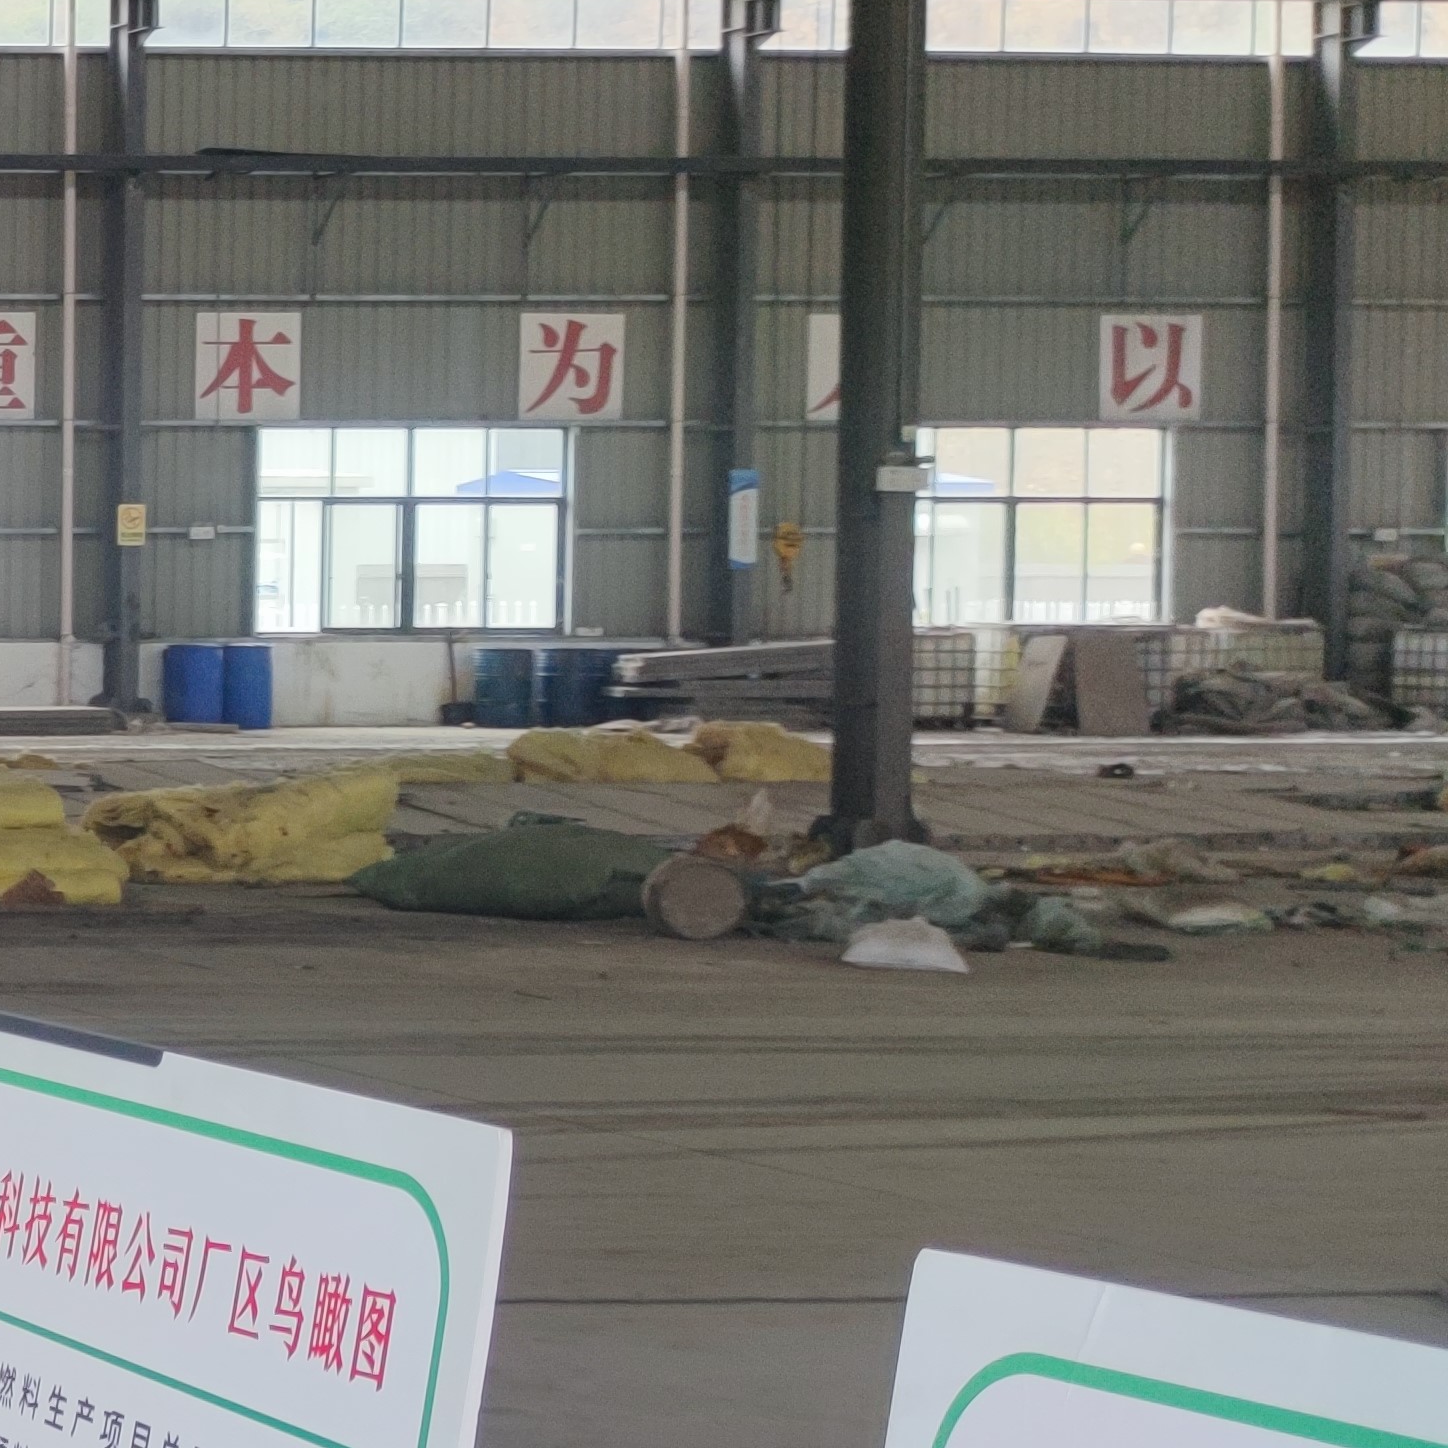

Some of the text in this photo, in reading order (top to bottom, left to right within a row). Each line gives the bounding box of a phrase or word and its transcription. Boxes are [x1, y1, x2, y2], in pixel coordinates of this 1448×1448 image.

[201, 318, 295, 414] 本
[526, 320, 617, 415] 为
[1111, 323, 1190, 412] 以
